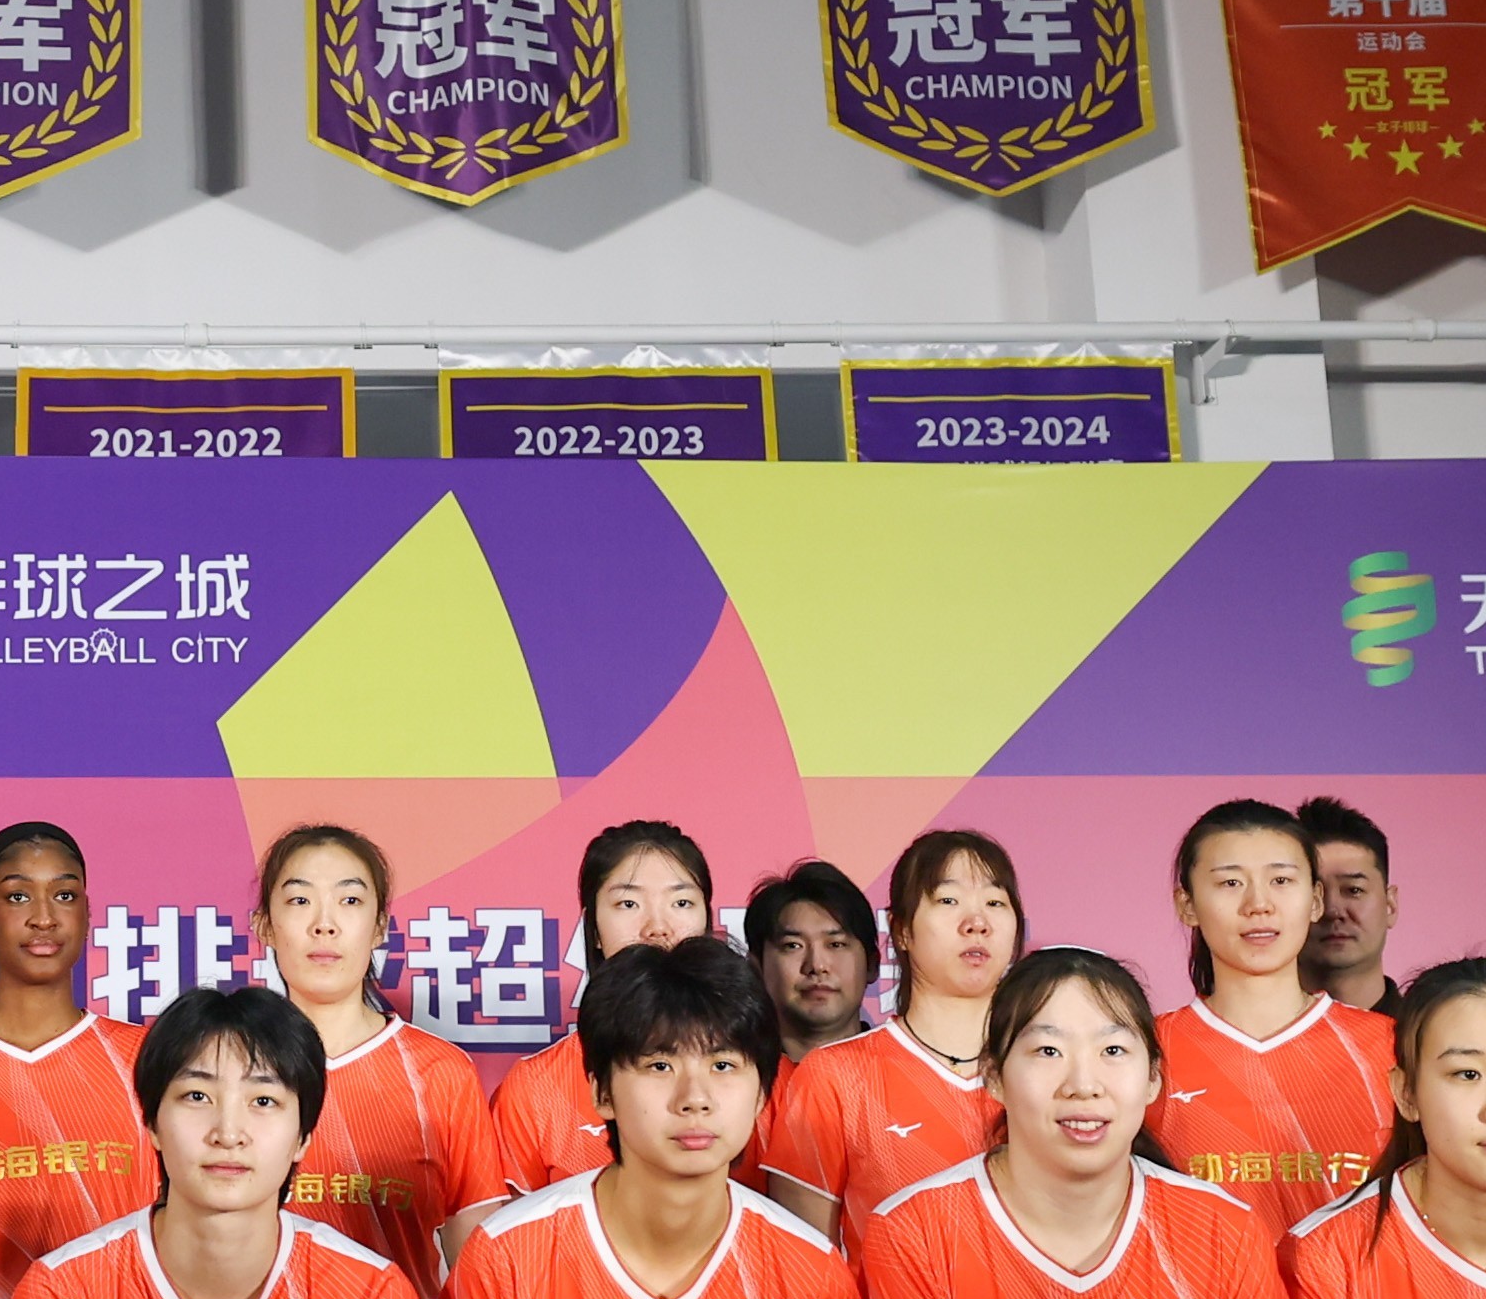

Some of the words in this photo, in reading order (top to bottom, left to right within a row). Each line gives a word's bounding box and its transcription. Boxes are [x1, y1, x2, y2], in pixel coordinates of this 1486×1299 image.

[1357, 32, 1426, 52] 运动会
[387, 81, 549, 115] CHAMPION
[906, 75, 1072, 100] CHAMPION
[1344, 67, 1450, 112] 冠军
[89, 427, 282, 457] 2021-2022
[514, 426, 704, 456] 2022-2023
[916, 416, 1110, 447] 2023-2024
[172, 635, 248, 664] CITY
[283, 1172, 416, 1212] 海银行
